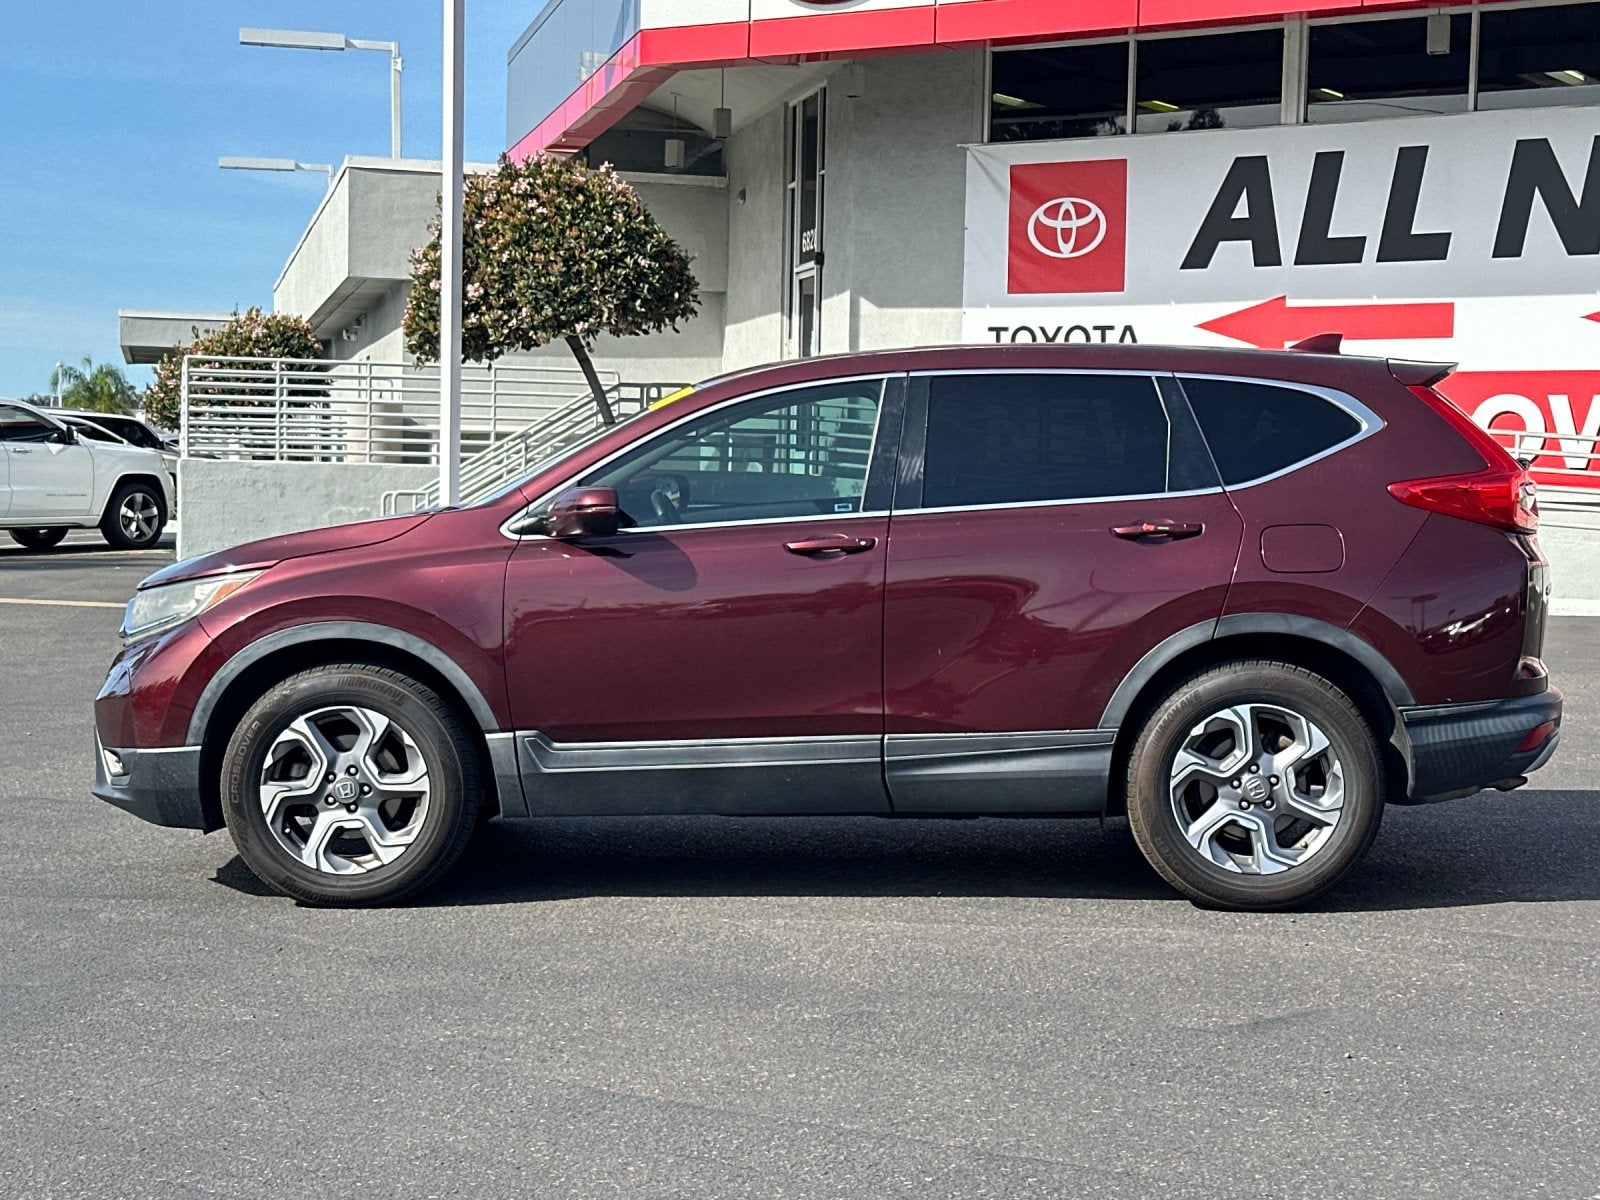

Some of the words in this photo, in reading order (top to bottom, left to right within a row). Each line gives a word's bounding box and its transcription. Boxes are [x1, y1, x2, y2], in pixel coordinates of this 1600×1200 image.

[1179, 145, 1453, 271] ALL
[1491, 135, 1600, 260] N
[987, 324, 1138, 344] TOYOTA
[231, 720, 262, 804] CROSSOVER
